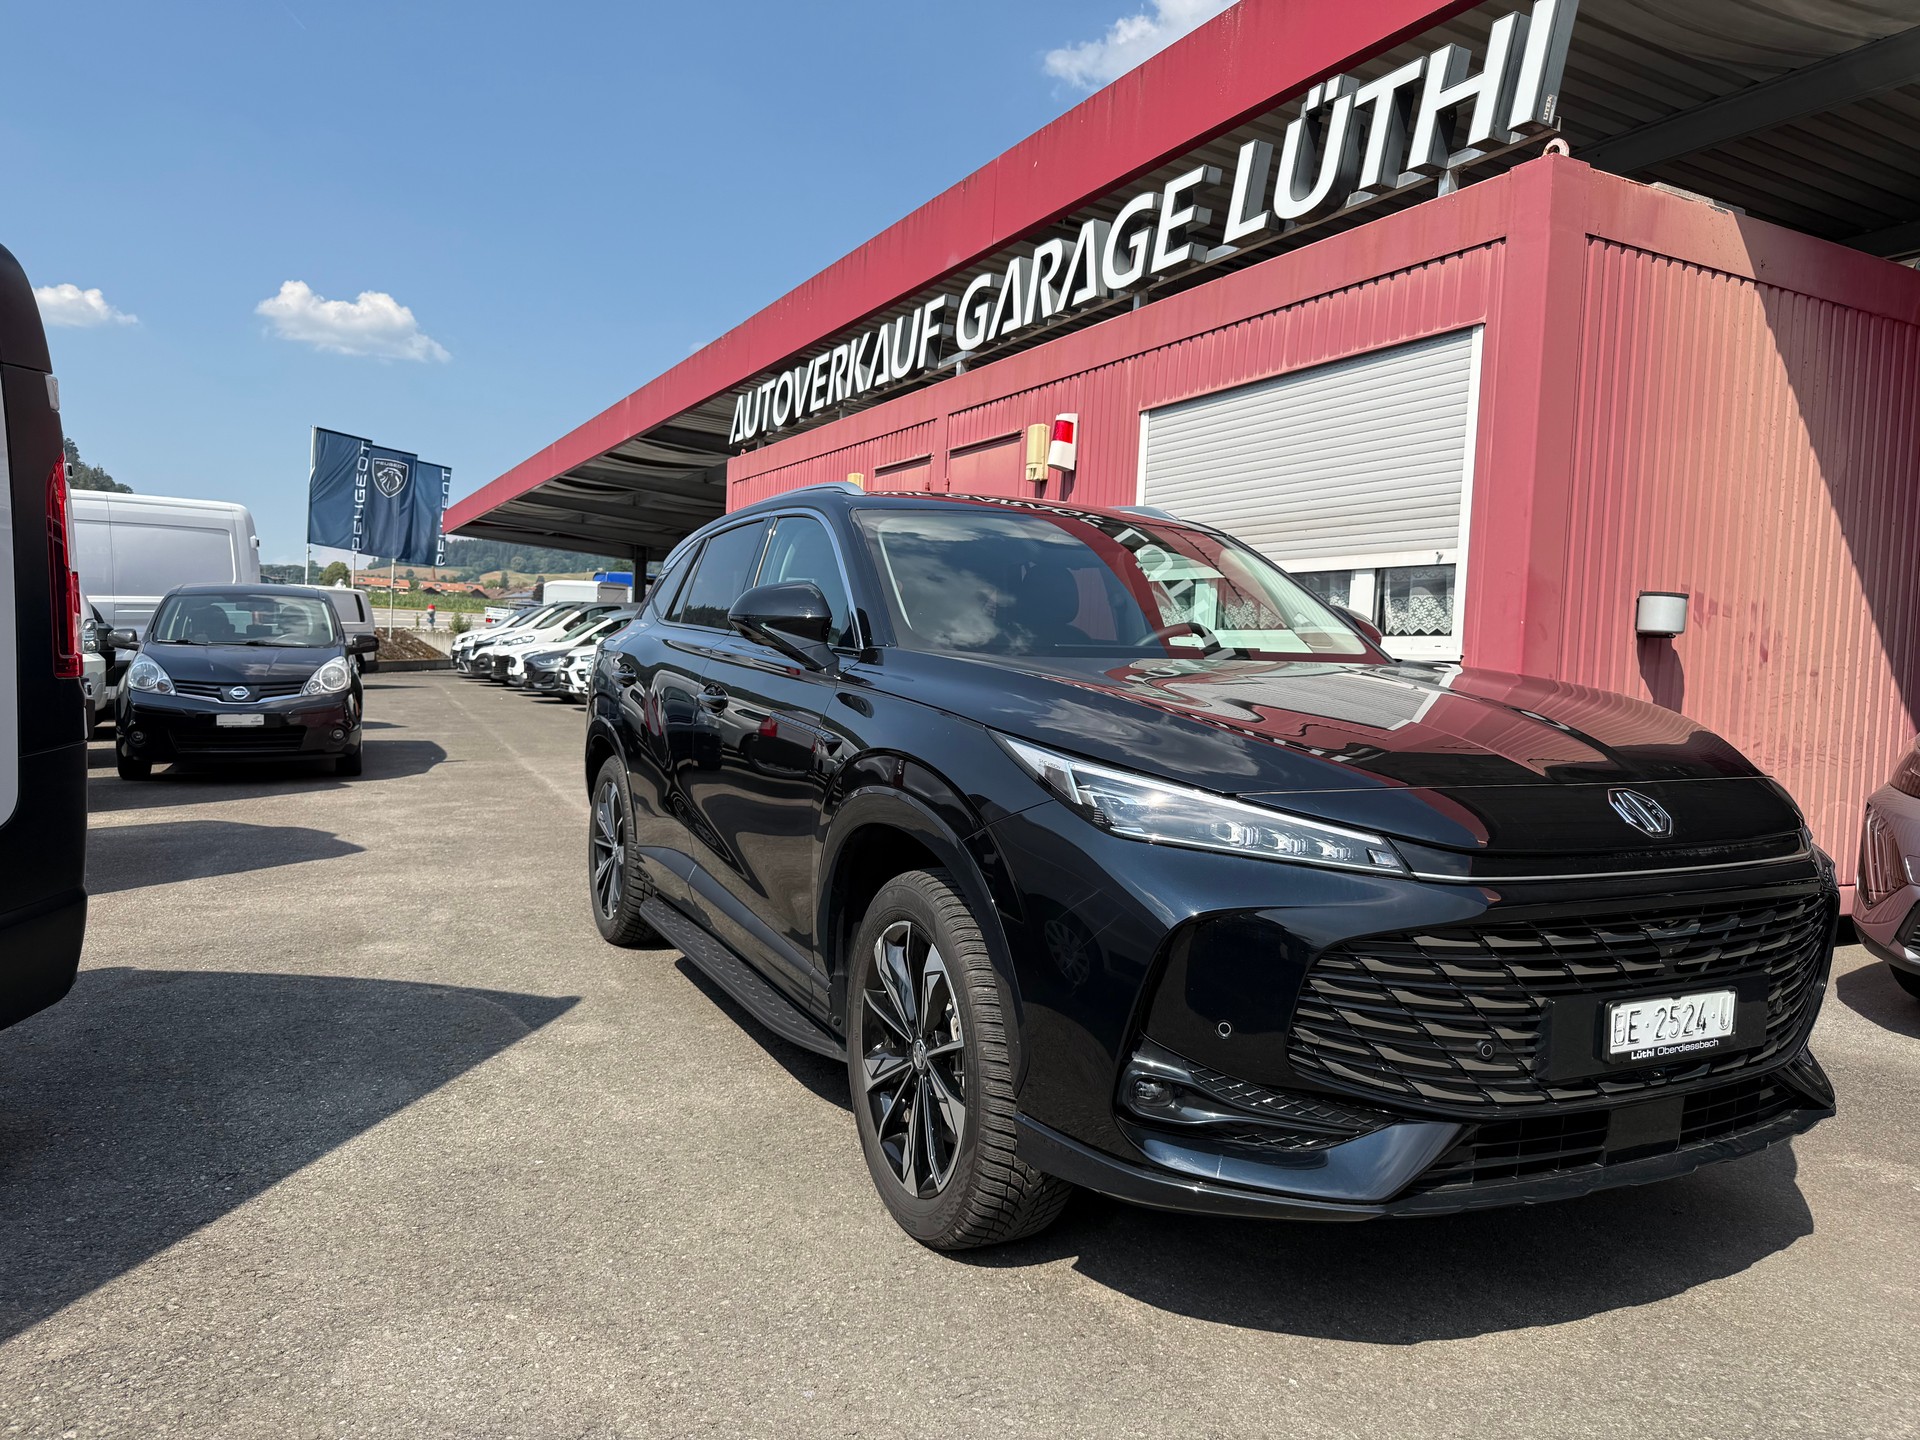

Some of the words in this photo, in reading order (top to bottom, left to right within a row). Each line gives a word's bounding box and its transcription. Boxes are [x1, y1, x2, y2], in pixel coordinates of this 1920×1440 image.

[729, 294, 948, 445] AUTOVERKAUF
[956, 165, 1206, 351] GARAGE
[1223, 0, 1558, 245] LÜTHI
[352, 441, 371, 552] PEUGEOT
[375, 460, 406, 469] PEUGEOT
[435, 468, 451, 567] PEEOT
[1631, 1050, 1655, 1060] Lüthi
[1657, 1038, 1719, 1056] Oberdiessbach
[1653, 1000, 1707, 1041] 2524
